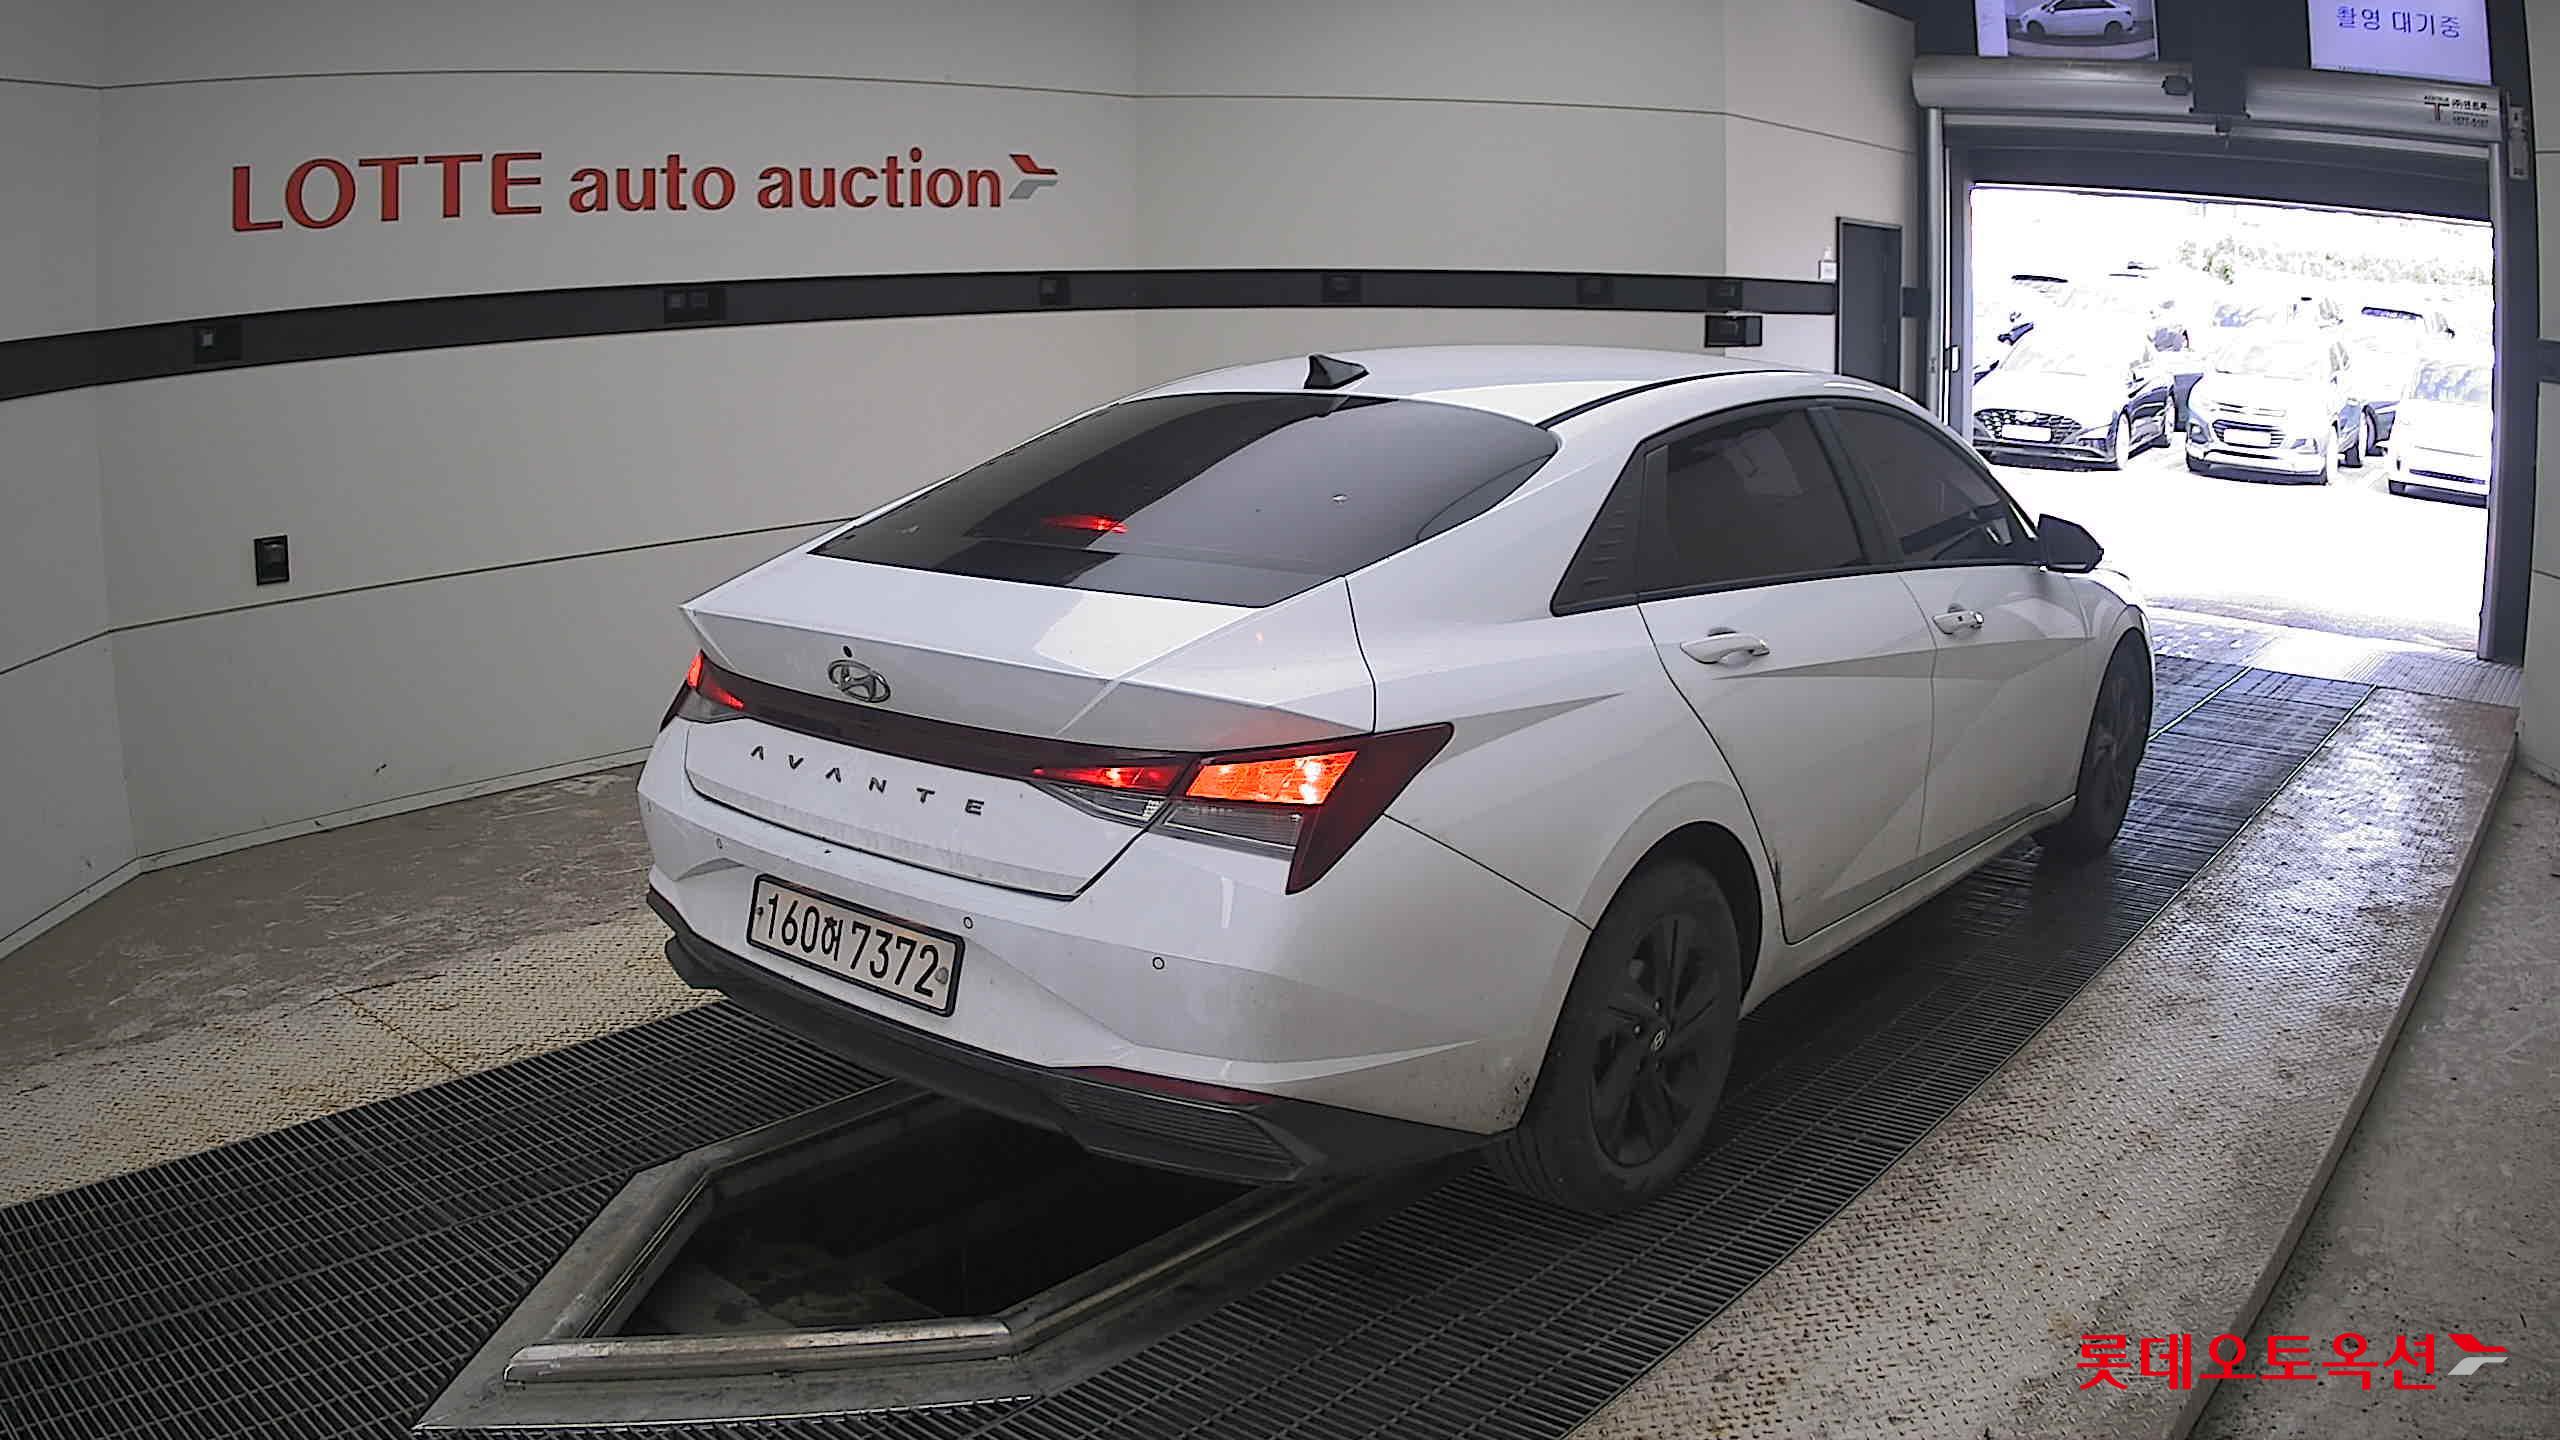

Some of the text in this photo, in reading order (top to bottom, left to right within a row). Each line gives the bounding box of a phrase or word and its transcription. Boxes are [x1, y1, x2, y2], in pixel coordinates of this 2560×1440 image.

[2337, 6, 2381, 31] 촬영
[232, 147, 1002, 232] LOTTE auto auction
[750, 745, 985, 816] AVANTE
